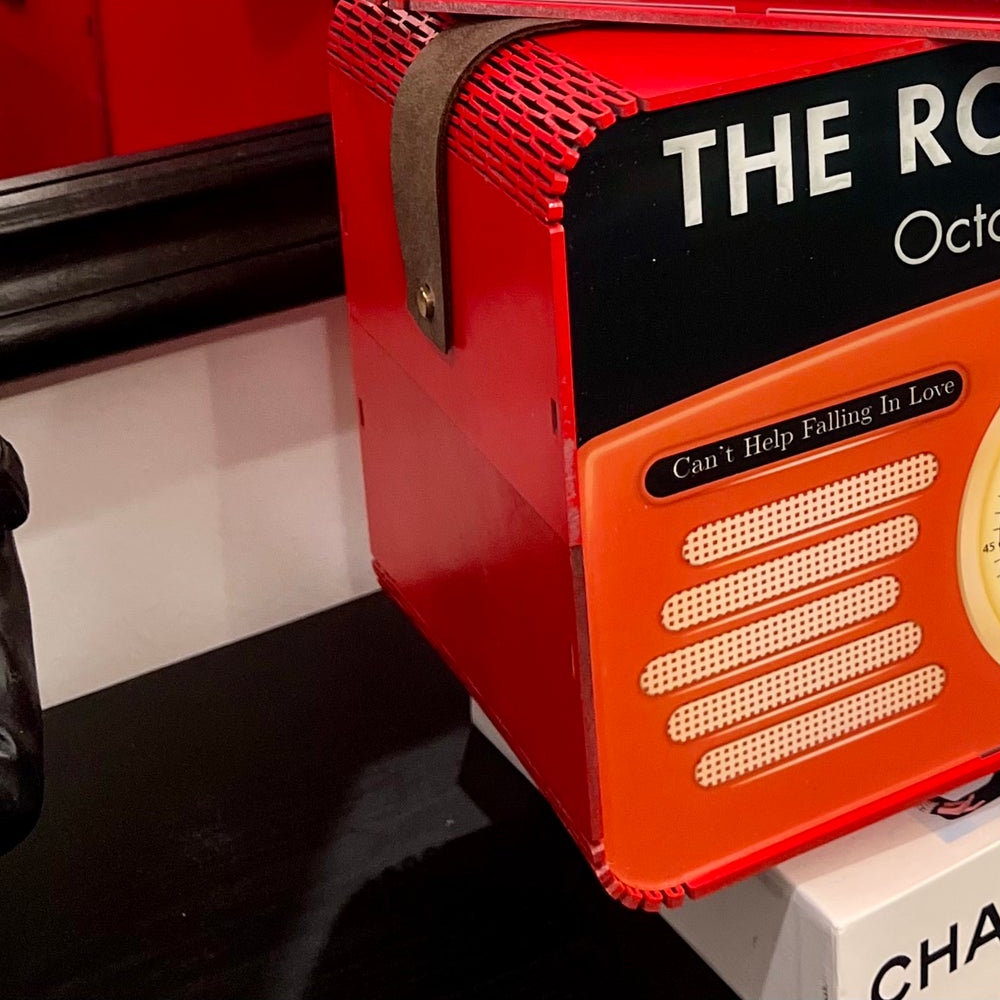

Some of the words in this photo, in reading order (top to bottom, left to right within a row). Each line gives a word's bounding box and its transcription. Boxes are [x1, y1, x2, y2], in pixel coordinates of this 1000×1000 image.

[662, 100, 852, 227] THE
[743, 428, 794, 458] Help
[801, 405, 873, 440] Falling
[880, 394, 901, 416] In
[908, 380, 955, 406] Love
[982, 541, 995, 553] 45
